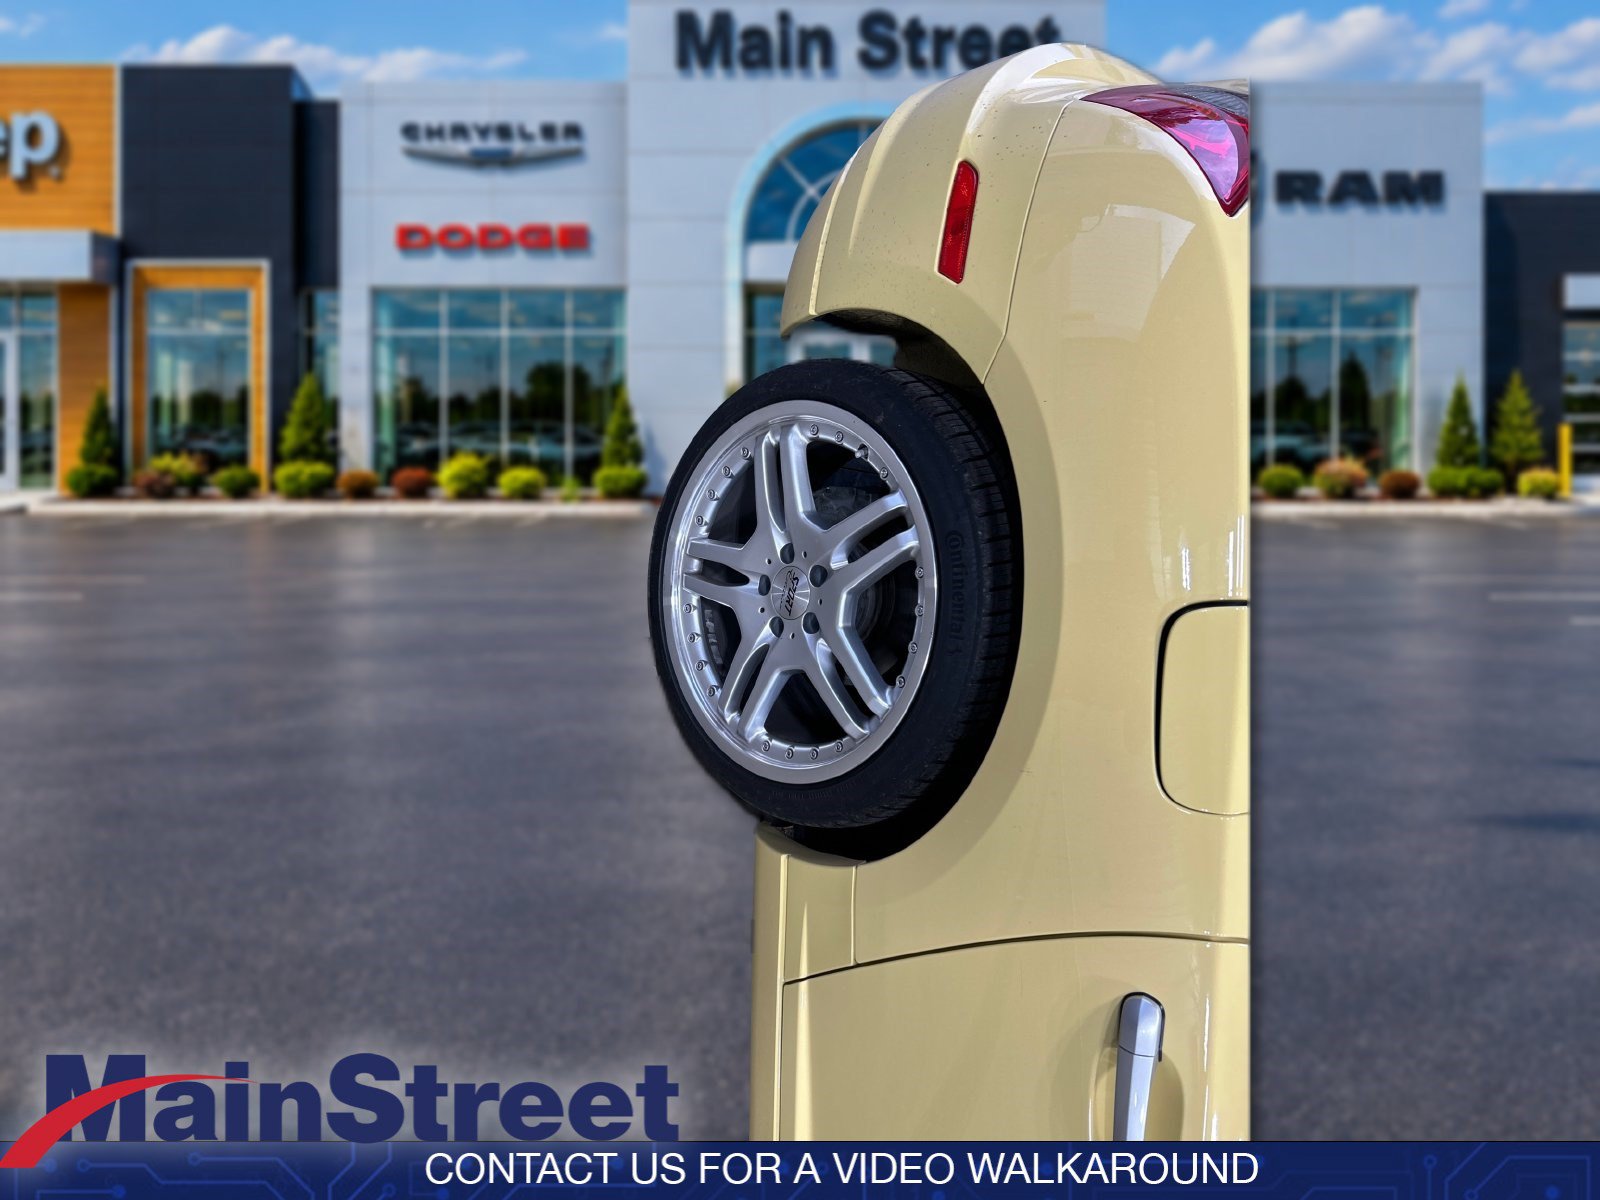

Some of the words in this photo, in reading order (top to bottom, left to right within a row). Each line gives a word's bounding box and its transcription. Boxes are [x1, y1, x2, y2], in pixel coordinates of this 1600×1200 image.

[675, 10, 834, 71] Main
[401, 122, 584, 141] CHRYSLER
[1275, 168, 1445, 206] RAM
[396, 222, 591, 252] DODGE
[784, 571, 801, 617] SPORT
[945, 530, 967, 640] Continental
